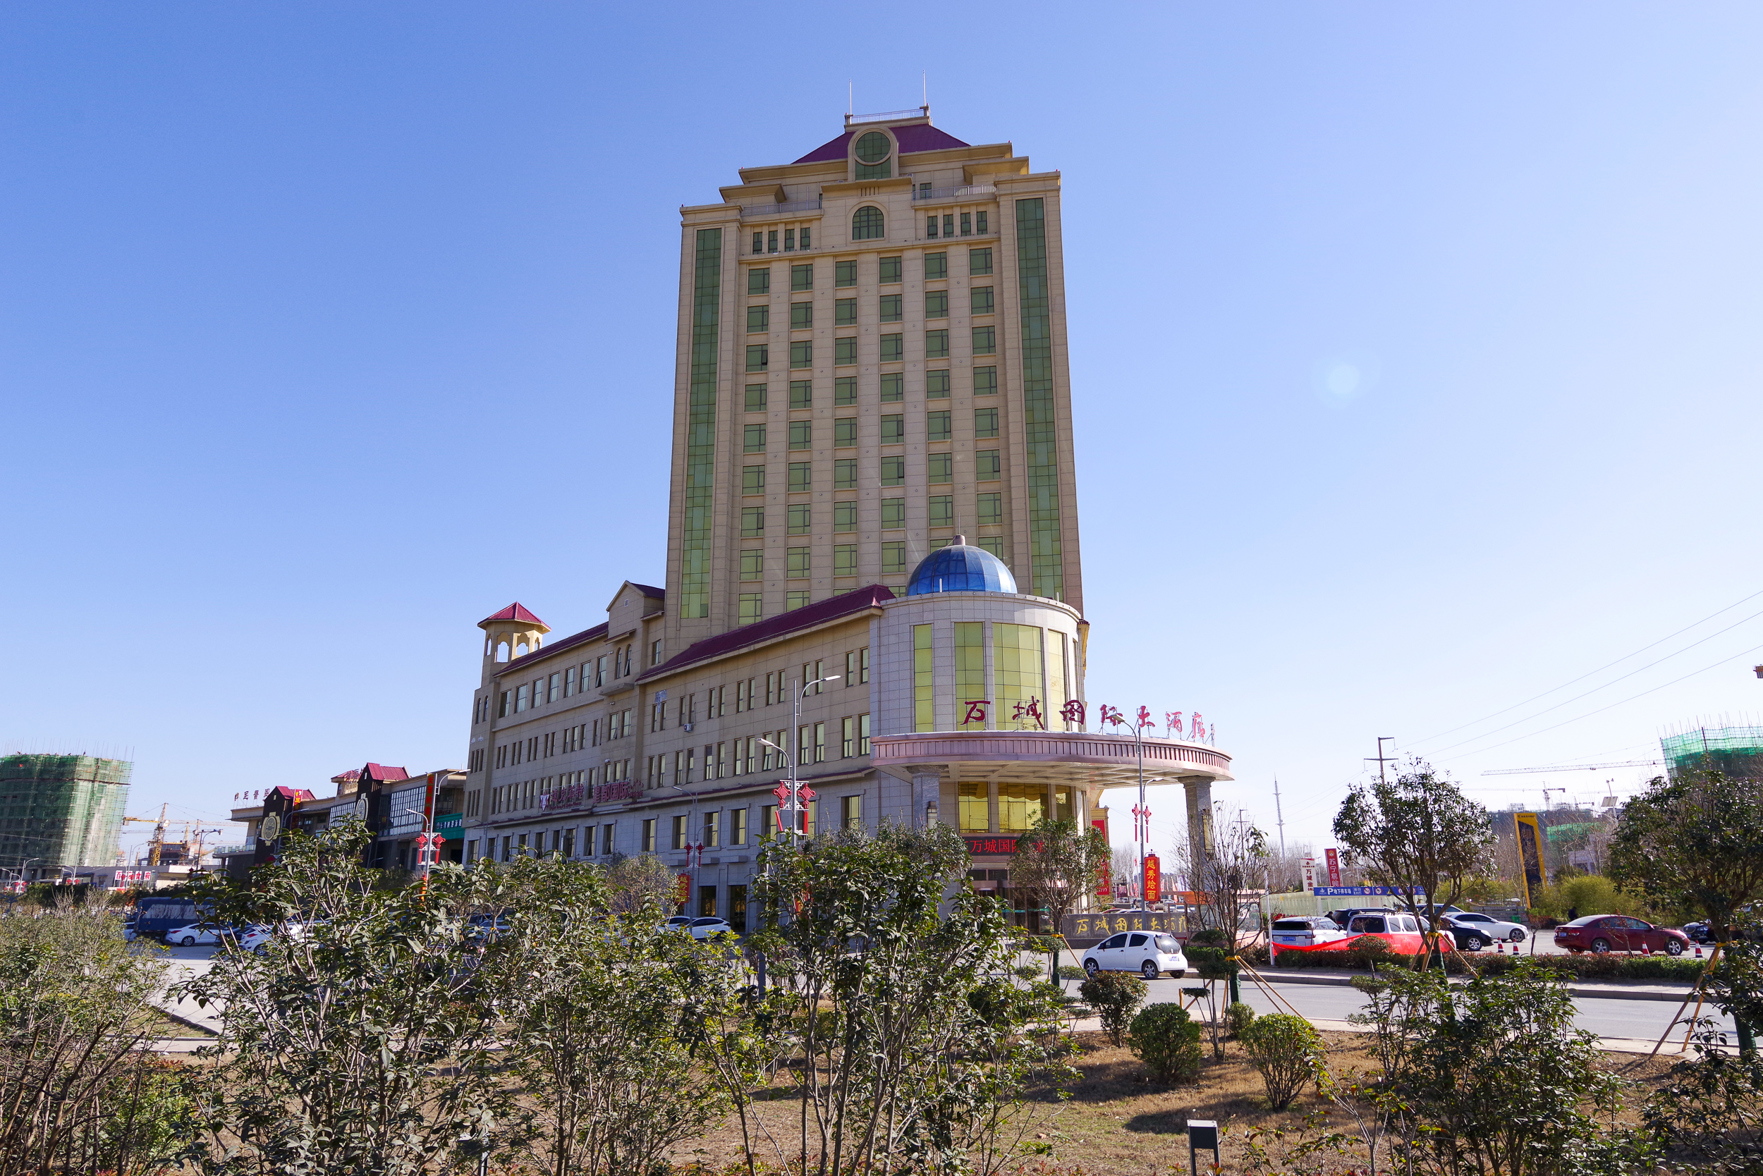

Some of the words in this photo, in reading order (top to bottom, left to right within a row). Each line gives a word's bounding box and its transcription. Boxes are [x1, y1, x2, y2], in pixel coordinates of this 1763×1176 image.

[960, 695, 1206, 739] 万城国际大酒店
